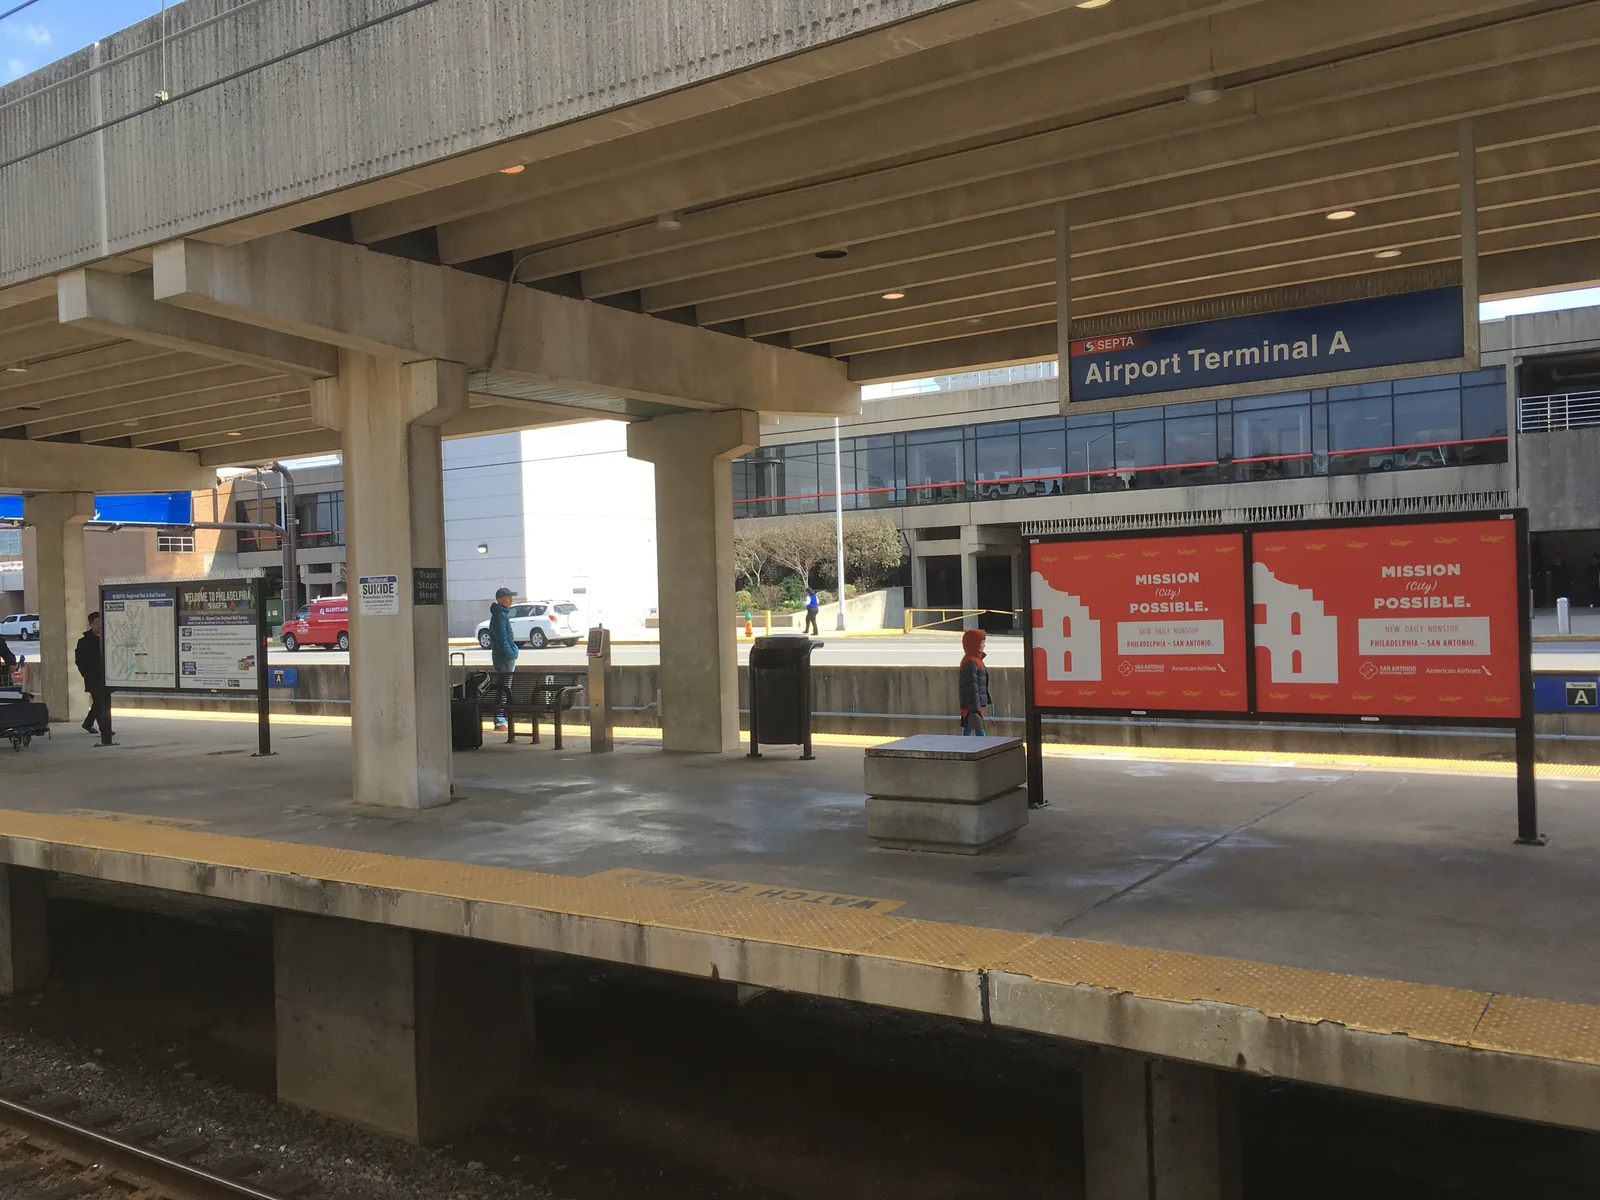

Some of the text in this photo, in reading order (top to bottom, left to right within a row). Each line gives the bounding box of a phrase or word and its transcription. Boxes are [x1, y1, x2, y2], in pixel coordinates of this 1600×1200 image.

[1097, 336, 1134, 350] SEPTA
[1085, 330, 1351, 386] Airport Terminal A
[420, 571, 437, 579] Train
[1381, 563, 1461, 578] MISSION
[1135, 572, 1200, 585] MISSION
[362, 583, 394, 595] SUICIDE
[418, 581, 439, 590] Stops
[1405, 580, 1438, 595] (City)
[184, 590, 251, 603] WELCOME TO PHILADELPHIA
[420, 591, 438, 599] Here
[1155, 587, 1181, 600] (City)
[1129, 601, 1209, 614] POSSIBLE.
[1374, 595, 1471, 610] POSSIBLE.
[1428, 624, 1461, 633] NONSTOP.
[1370, 639, 1419, 647] PHILADELPHIA
[1427, 639, 1441, 647] SAN
[1443, 639, 1477, 647] ANTONIO.
[1425, 666, 1482, 674] American Airlines
[276, 675, 281, 683] A
[1574, 690, 1589, 704] A
[685, 880, 749, 894] THE
[753, 887, 879, 909] WATCH
